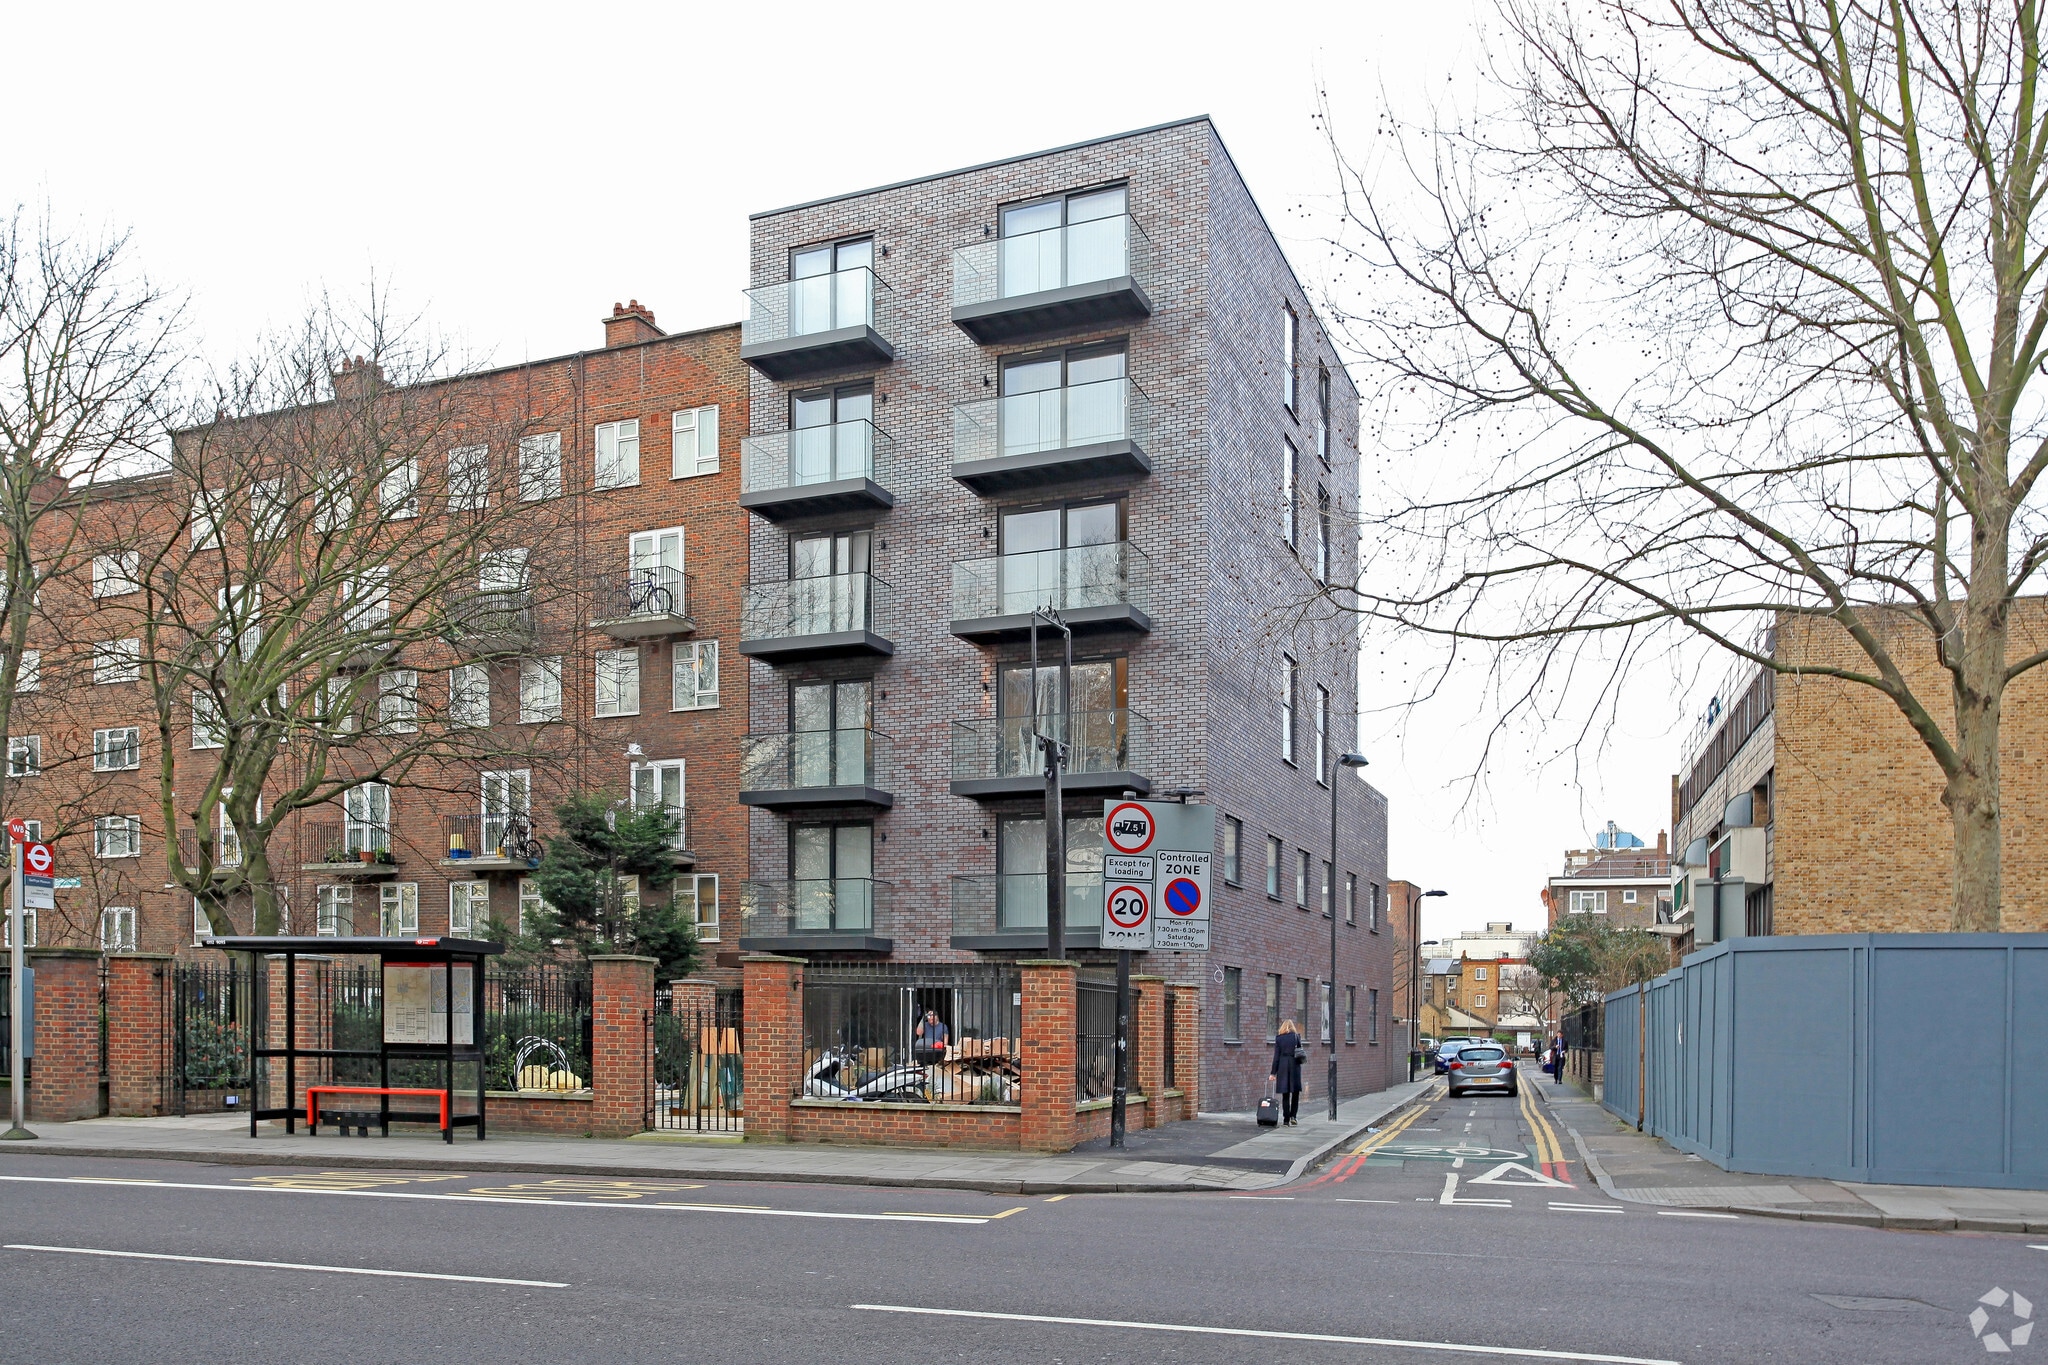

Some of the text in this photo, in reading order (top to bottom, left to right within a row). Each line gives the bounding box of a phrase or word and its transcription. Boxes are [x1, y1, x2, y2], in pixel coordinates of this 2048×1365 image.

[1159, 852, 1209, 863] Controlled
[1109, 859, 1150, 868] Except for
[1114, 868, 1144, 877] loading
[1165, 864, 1200, 875] ZONE
[1114, 898, 1143, 916] 20
